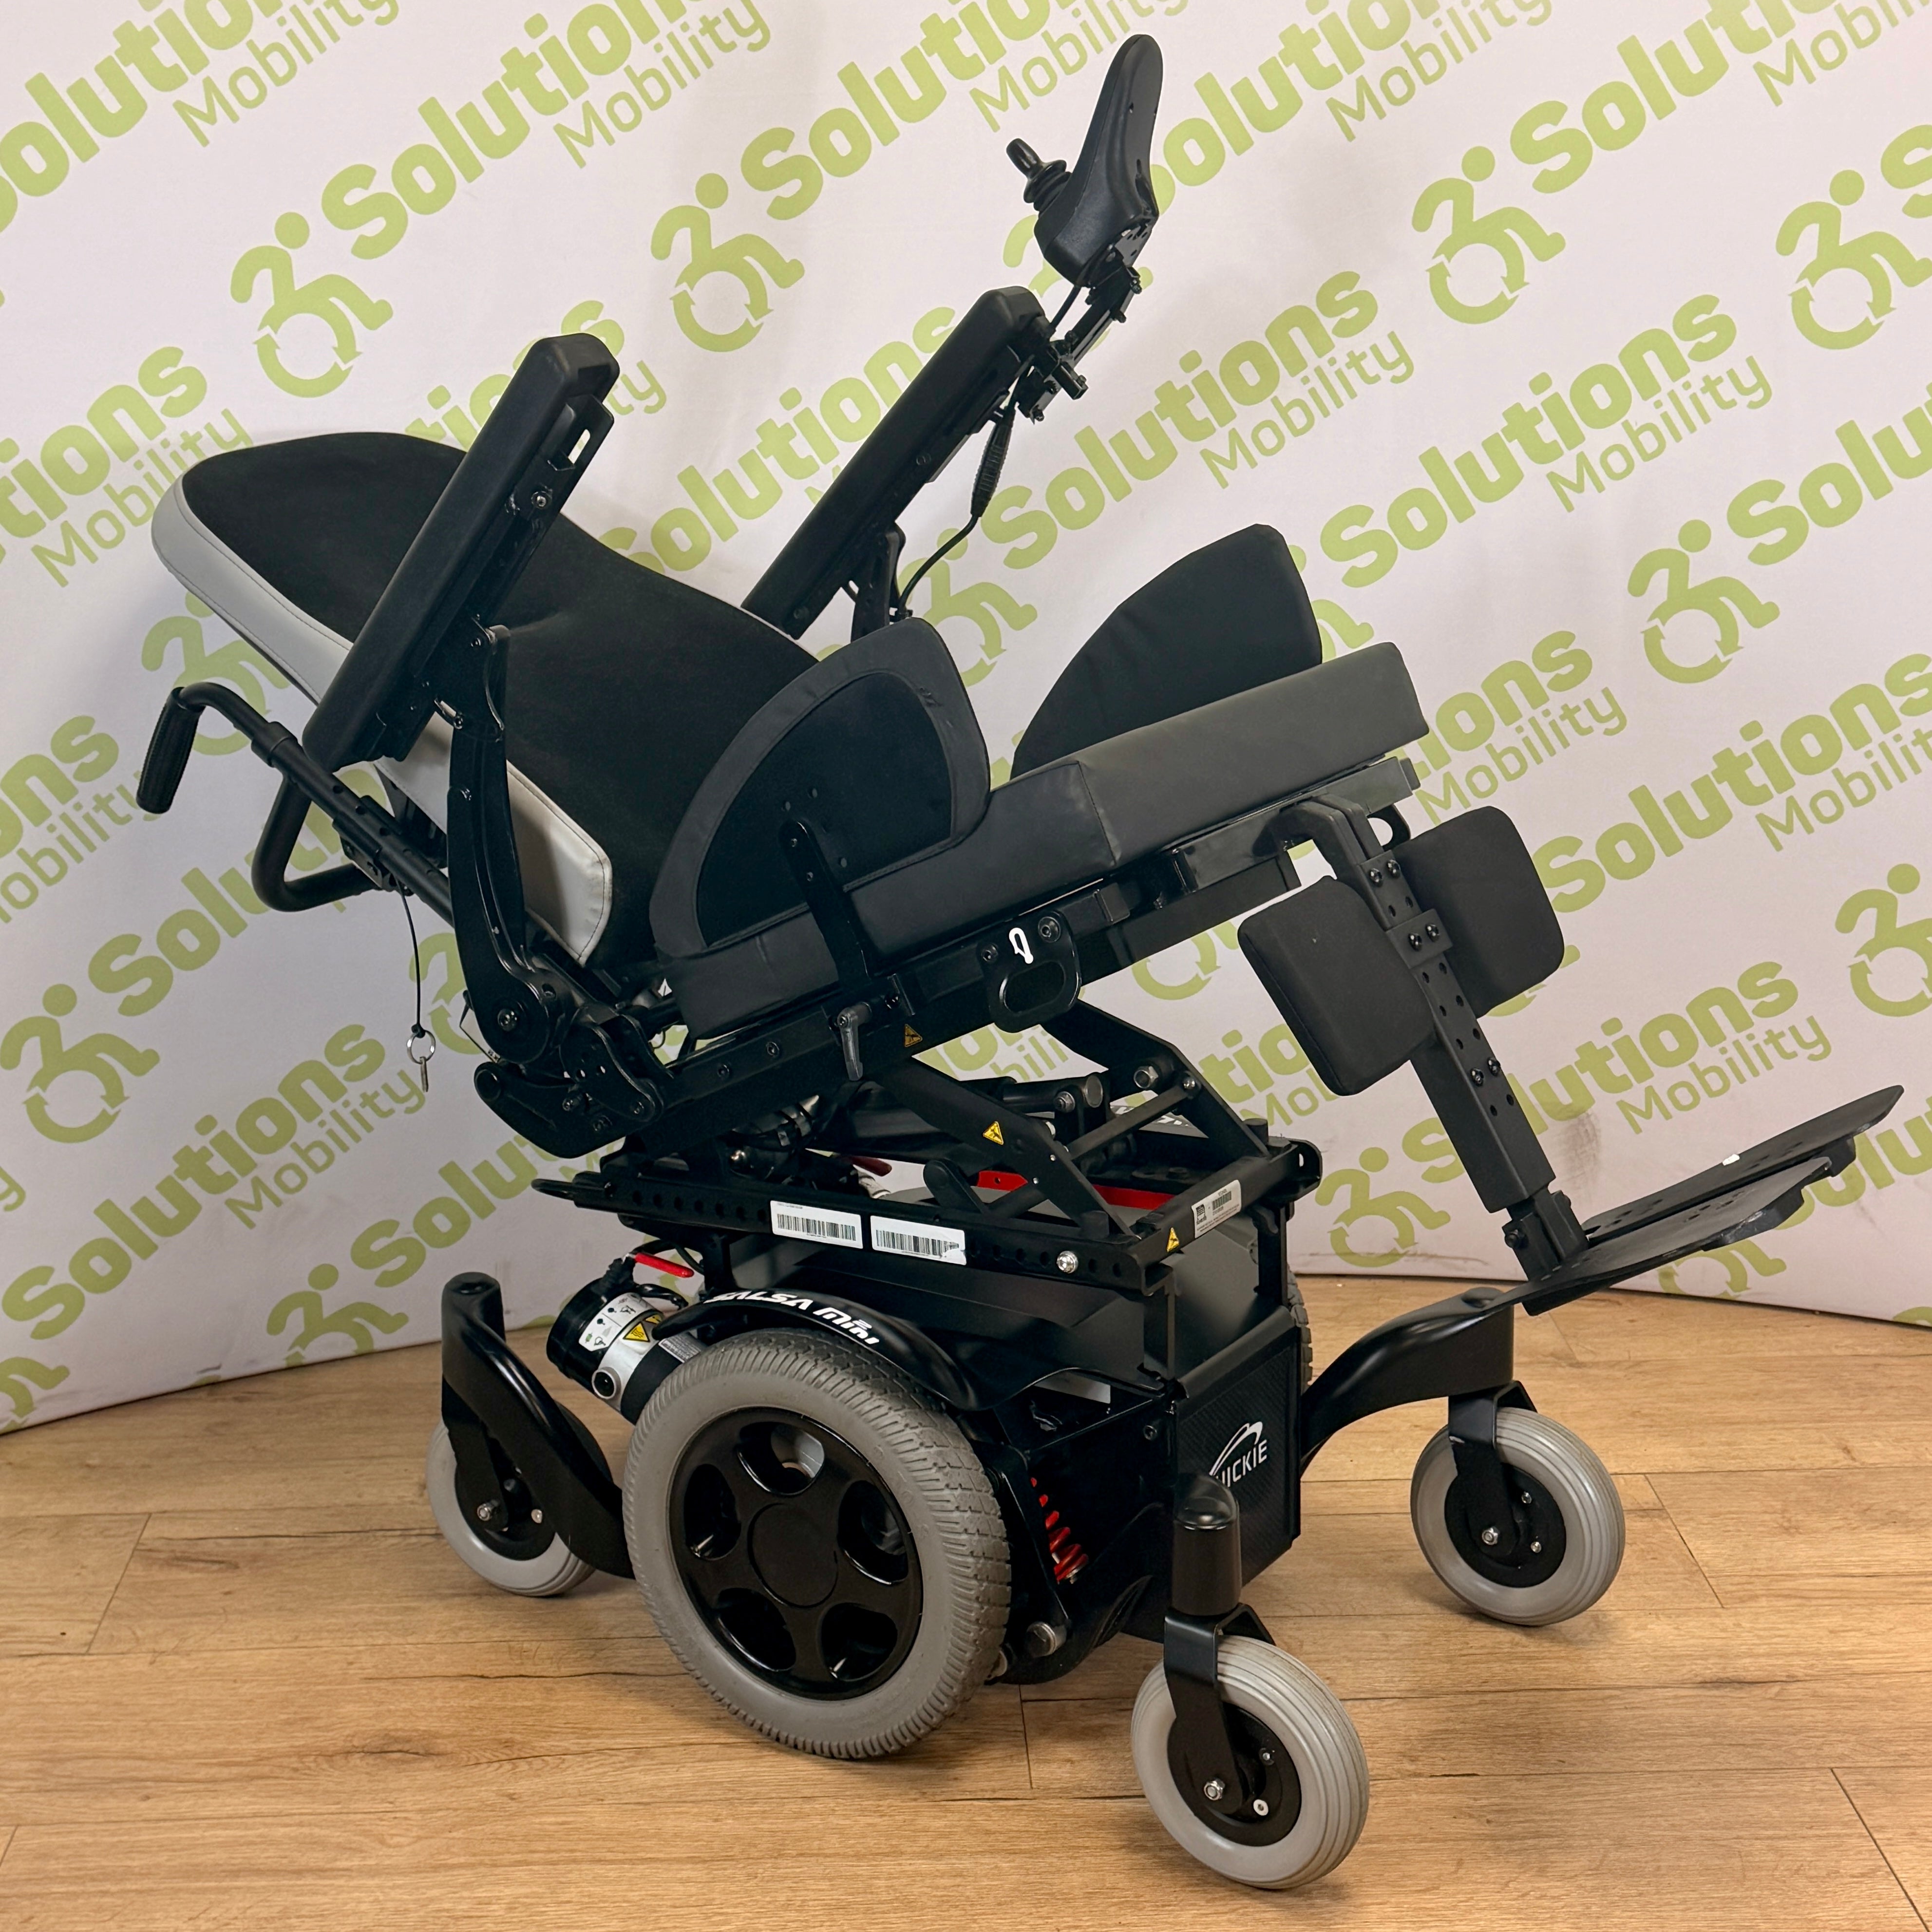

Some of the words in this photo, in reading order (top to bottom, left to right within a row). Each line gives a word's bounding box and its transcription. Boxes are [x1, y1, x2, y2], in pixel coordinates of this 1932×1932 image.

[0, 0, 283, 232] olutio
[553, 0, 771, 168] Mobility
[740, 0, 1075, 221] Solutio
[1149, 0, 1439, 214] olutio
[1510, 0, 1835, 194] Soluti
[980, 270, 1378, 570] Solutions
[1200, 332, 1414, 489] Mobility
[1320, 294, 1737, 588] Solutions
[1547, 356, 1772, 512] Mobility
[0, 770, 162, 923] obilit
[1415, 689, 1627, 826] Mobility
[1532, 653, 1932, 913] Solutions
[226, 1072, 426, 1228] Mobility
[1617, 1017, 1831, 1134] Mobility
[1, 1025, 385, 1340] Solutions
[703, 1290, 814, 1310] SALSA
